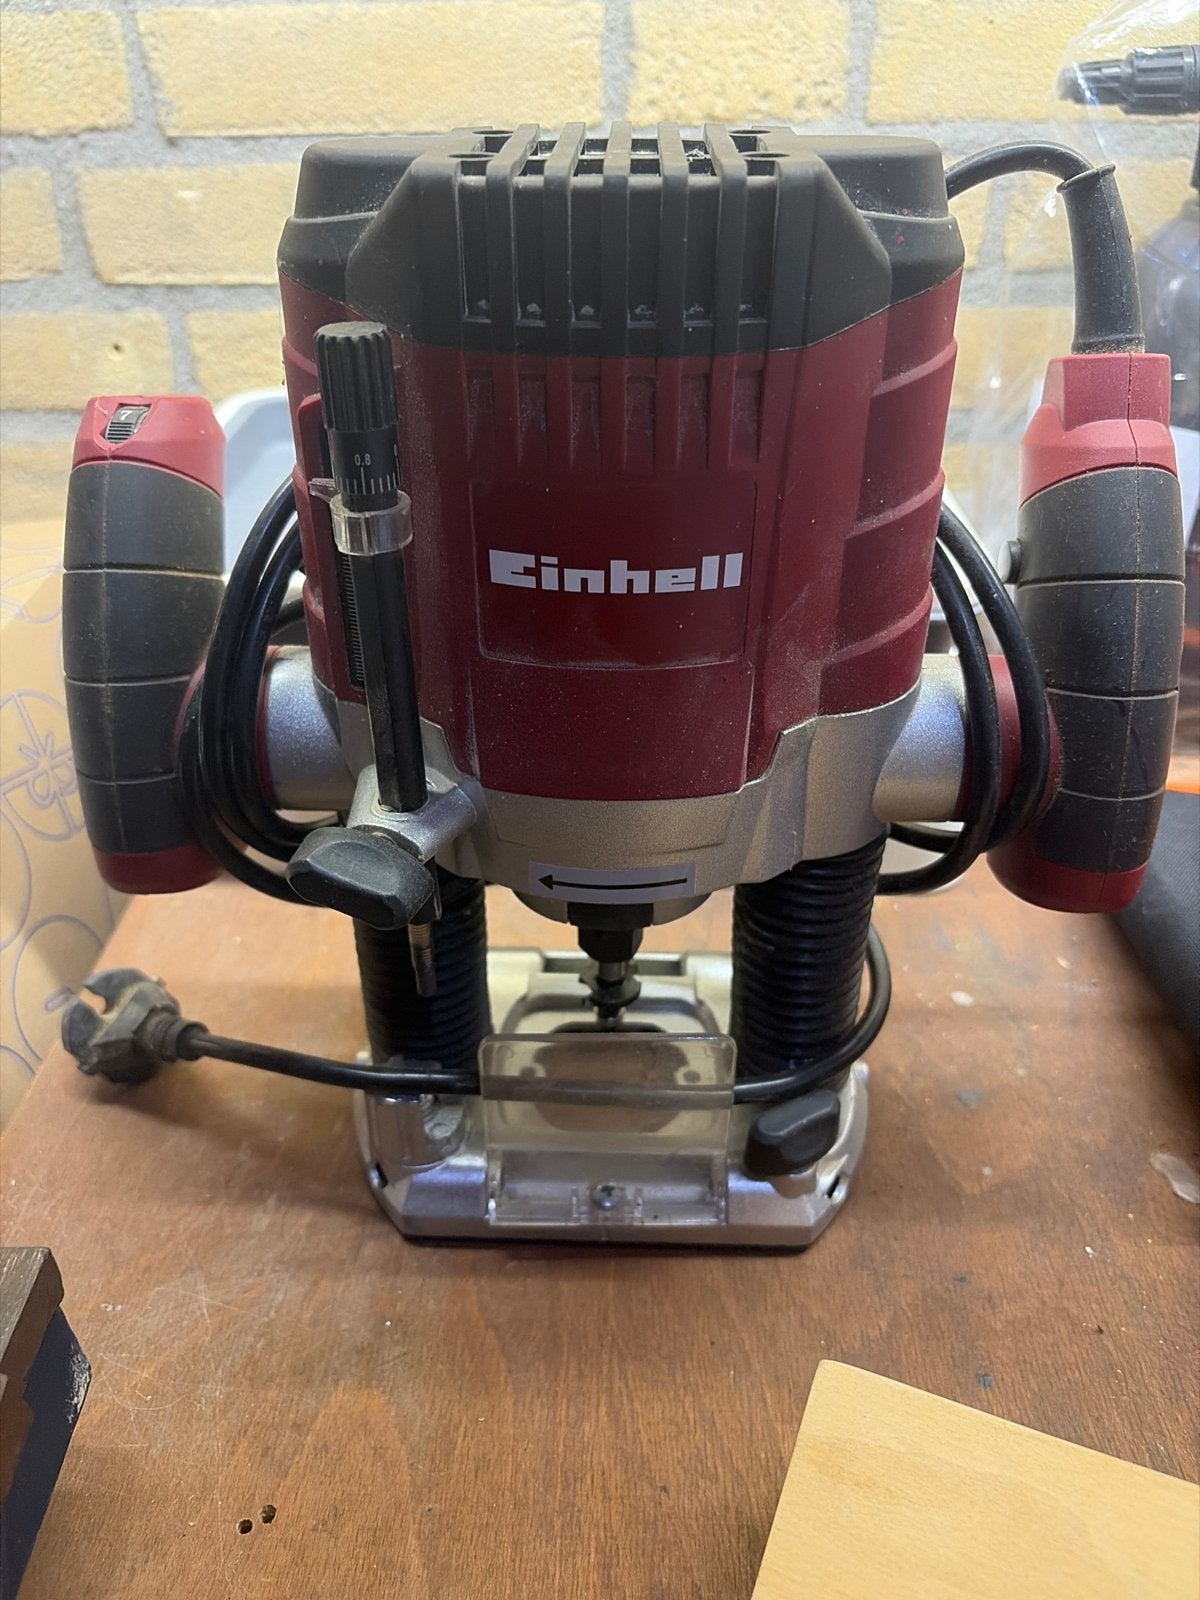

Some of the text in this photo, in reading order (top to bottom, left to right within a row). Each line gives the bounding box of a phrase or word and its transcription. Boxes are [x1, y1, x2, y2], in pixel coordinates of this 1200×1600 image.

[120, 410, 133, 421] 7
[354, 453, 371, 466] 0.8
[489, 549, 743, 594] Einhell
